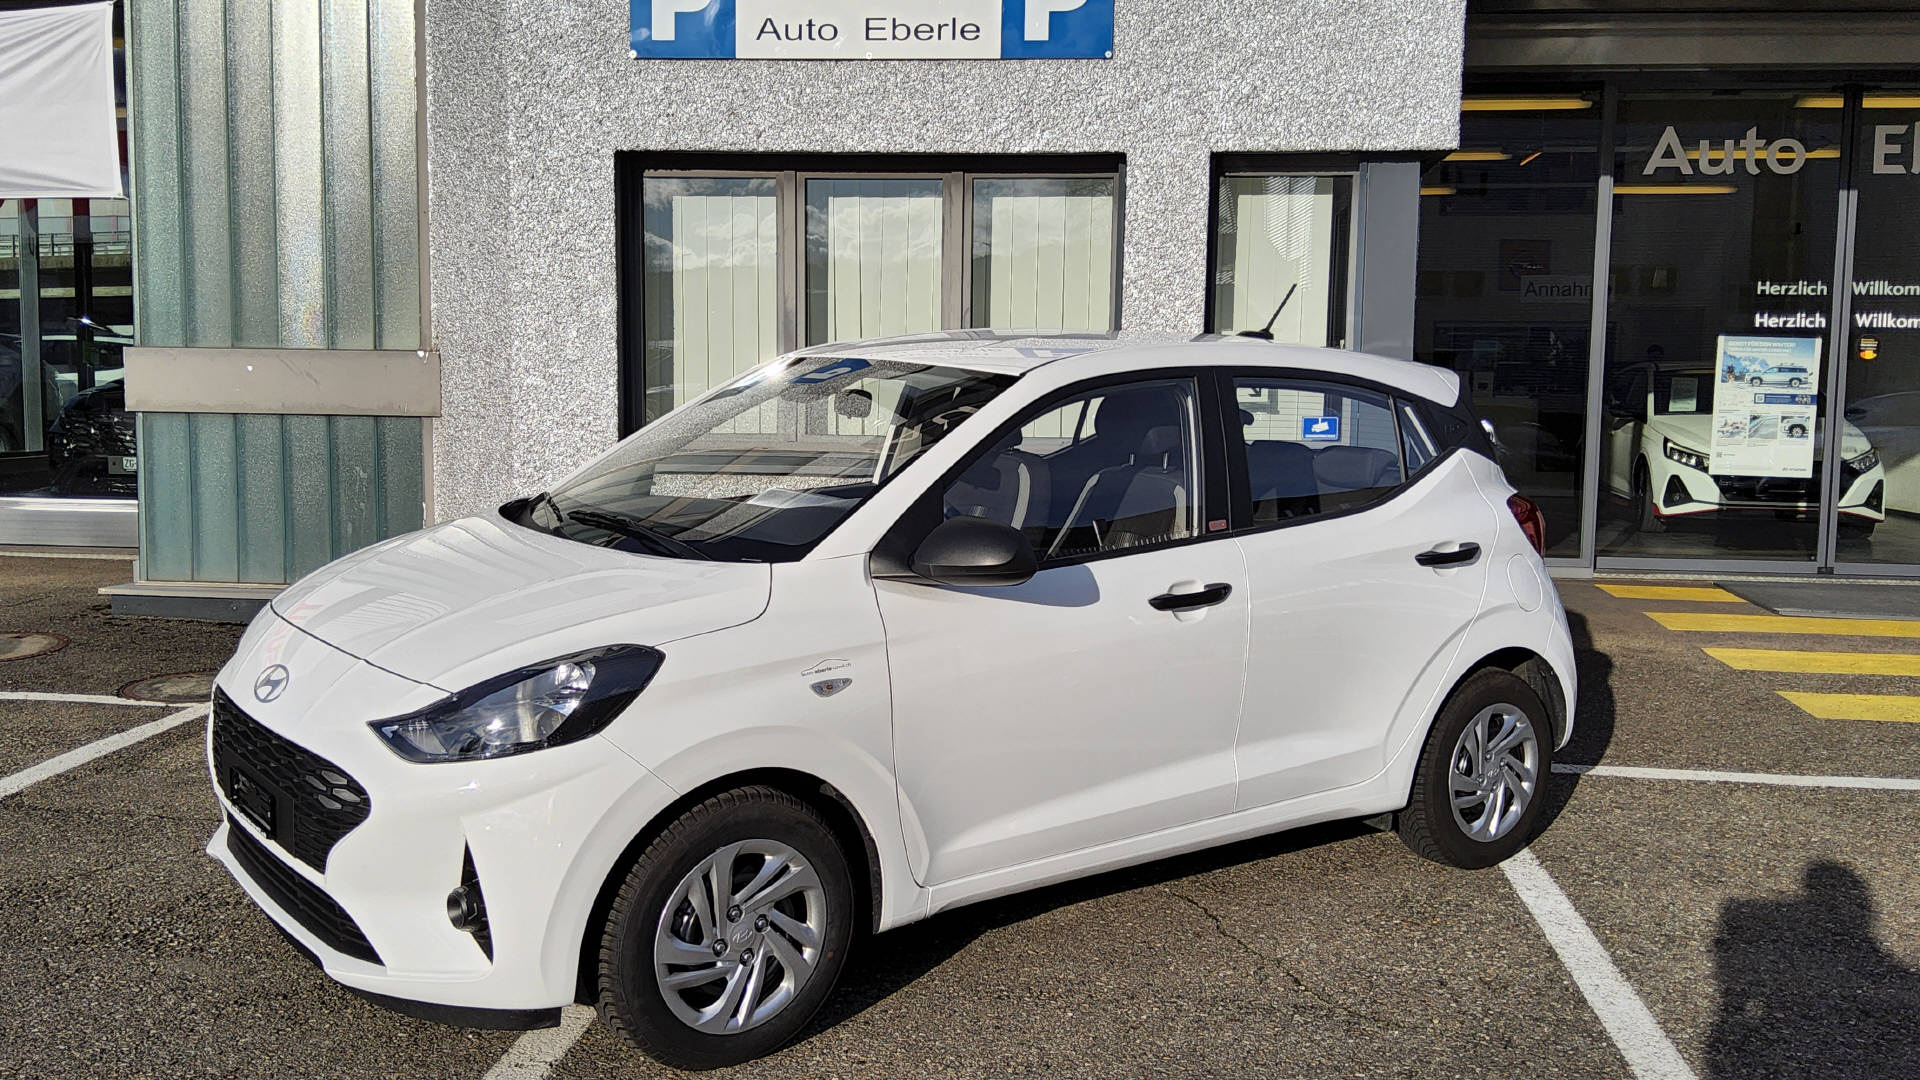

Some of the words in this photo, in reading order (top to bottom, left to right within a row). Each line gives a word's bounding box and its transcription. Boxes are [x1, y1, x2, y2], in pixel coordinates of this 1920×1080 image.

[755, 17, 839, 41] Auto
[864, 17, 981, 41] Eberle
[1642, 125, 1806, 176] Auto
[1873, 121, 1920, 175] E
[1756, 280, 1828, 296] Herzlich
[1754, 312, 1827, 328] Herzlich
